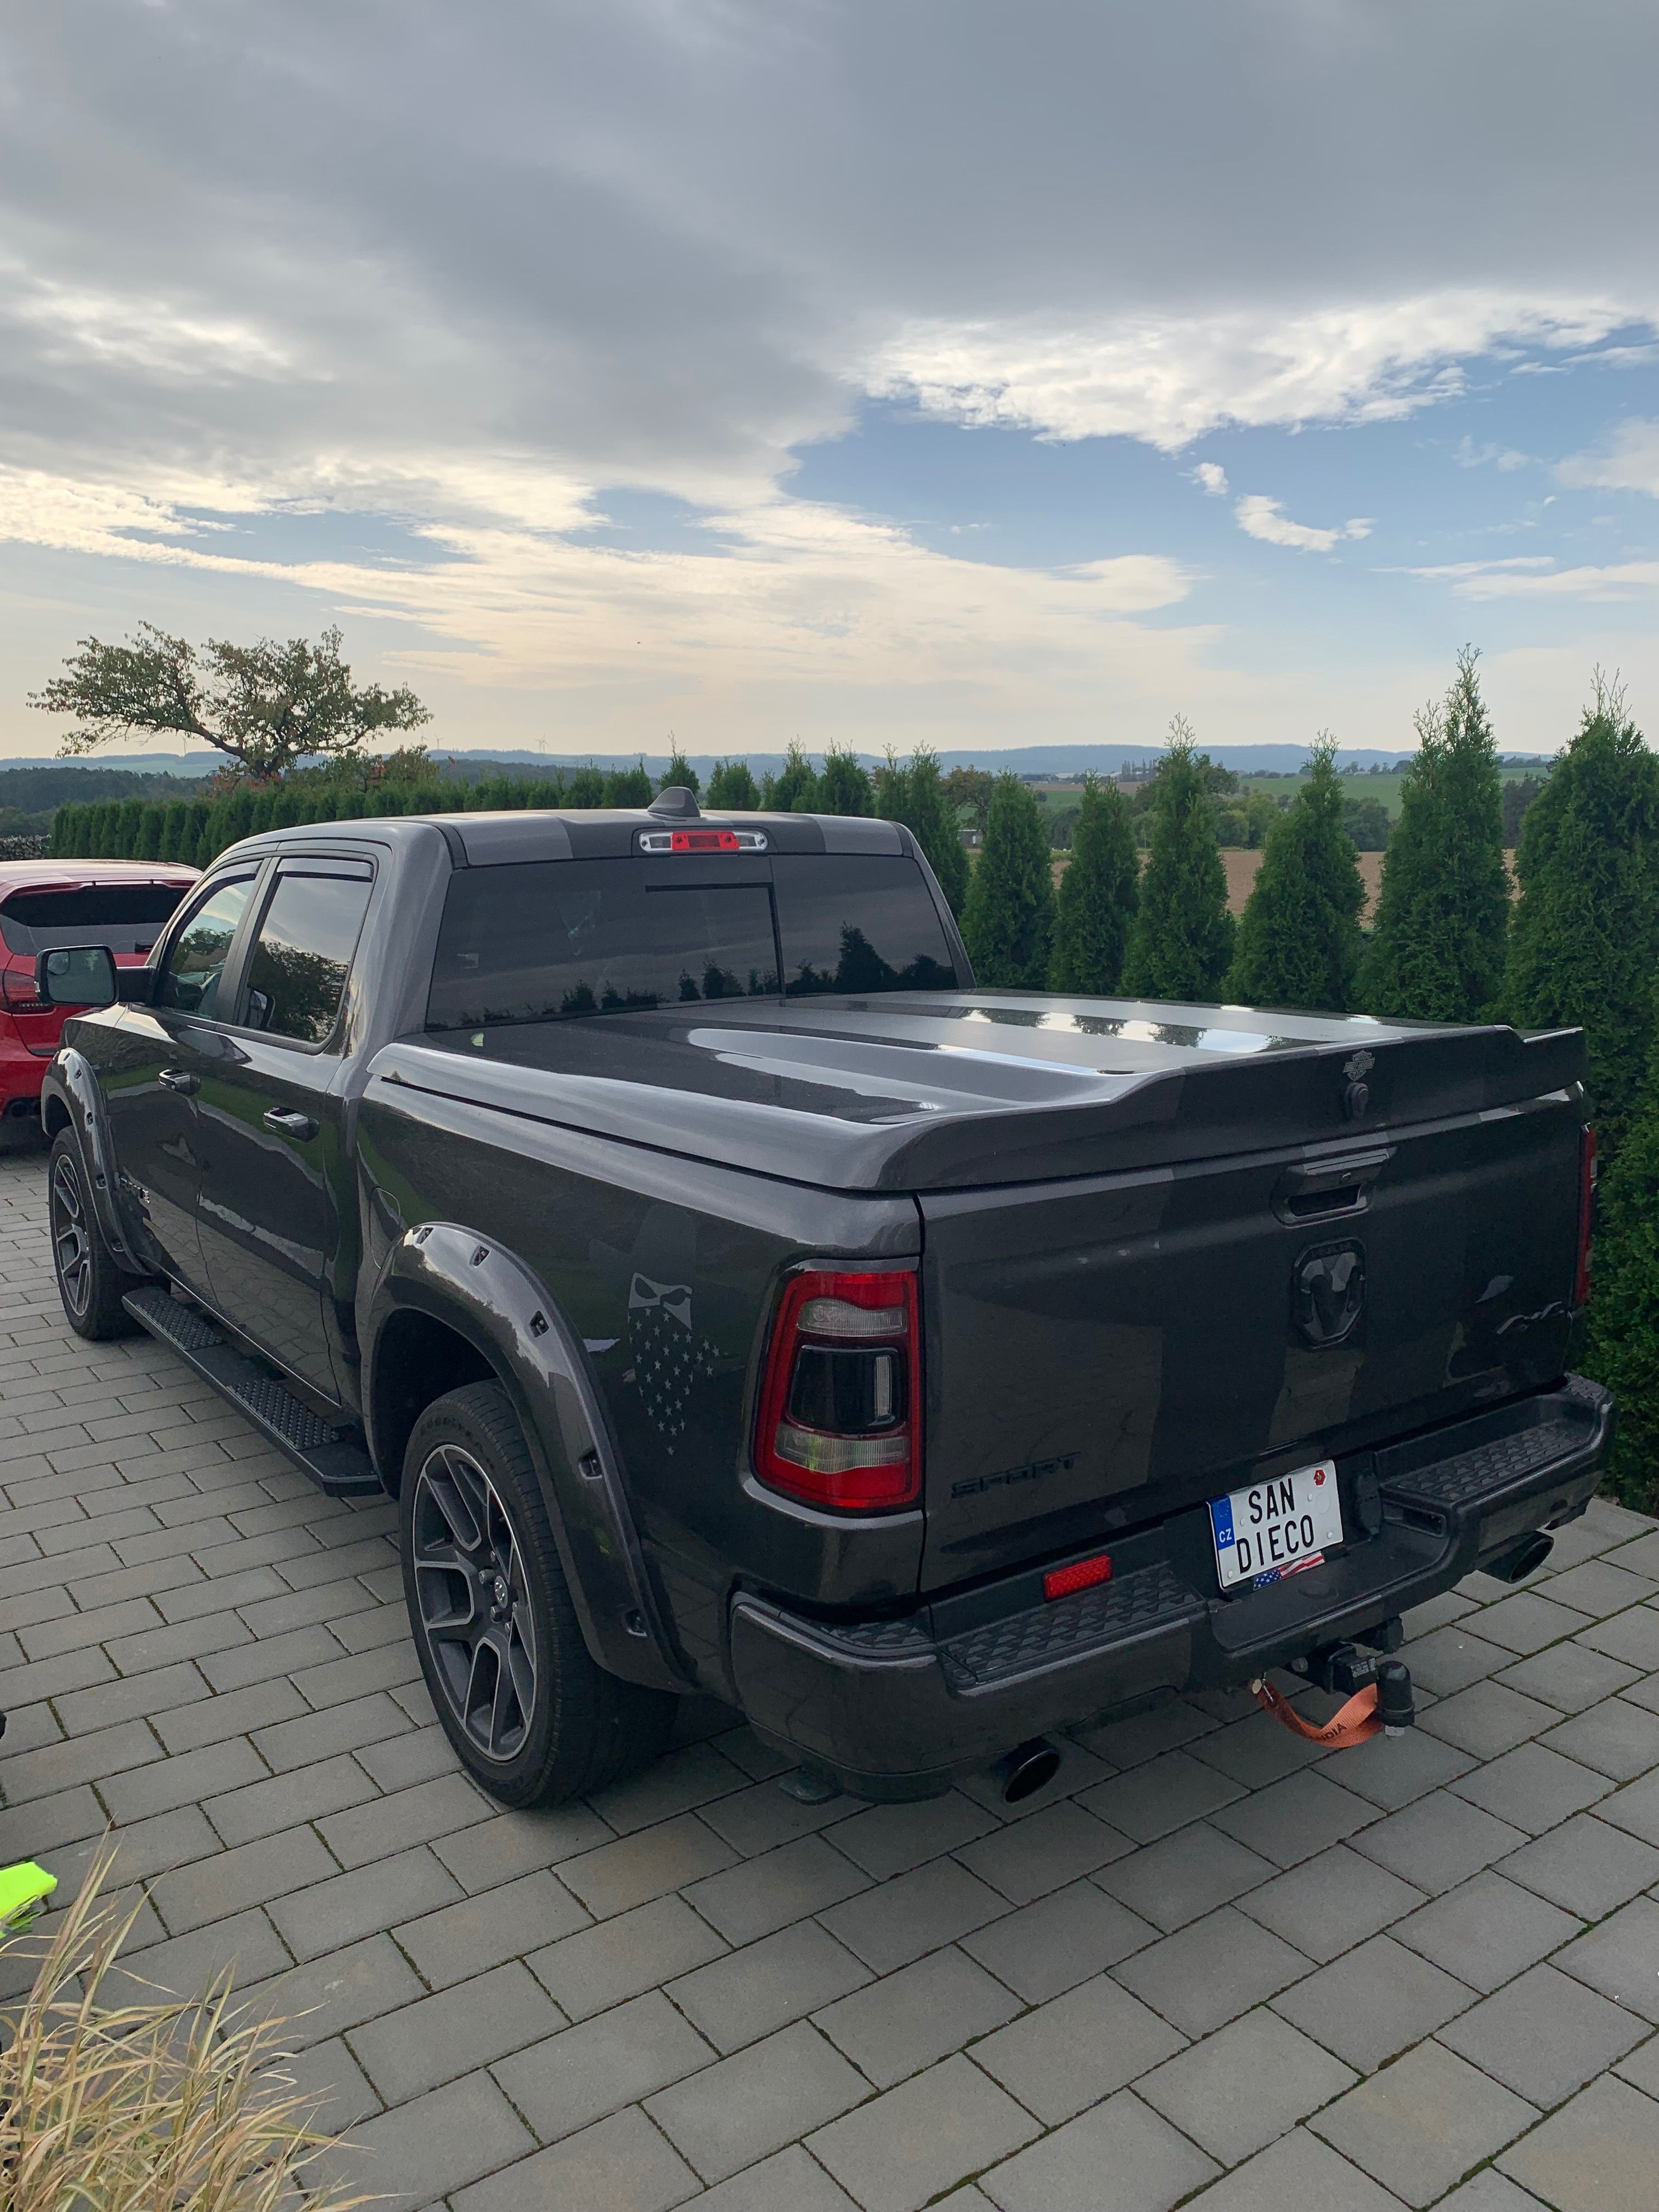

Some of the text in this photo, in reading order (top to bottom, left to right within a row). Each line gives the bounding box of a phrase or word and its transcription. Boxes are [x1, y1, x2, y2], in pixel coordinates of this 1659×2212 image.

[951, 1451, 1082, 1499] SPORT
[1248, 1478, 1295, 1523] SAN
[1218, 1528, 1232, 1543] CZ
